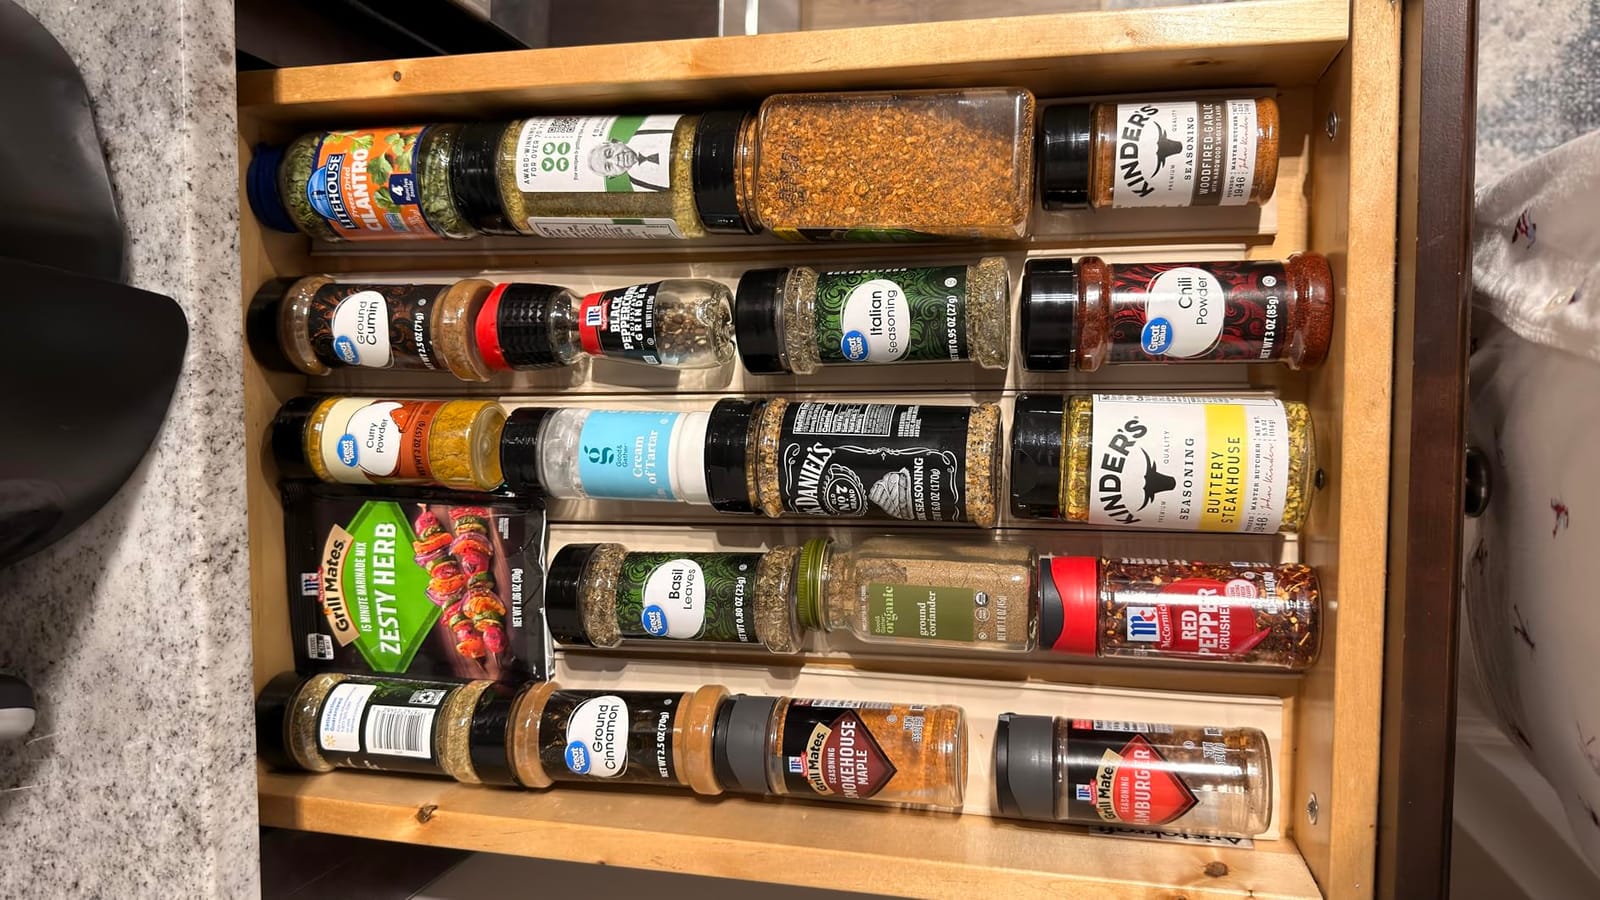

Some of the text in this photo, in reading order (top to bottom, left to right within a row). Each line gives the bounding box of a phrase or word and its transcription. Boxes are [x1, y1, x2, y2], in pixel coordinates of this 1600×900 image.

[523, 127, 537, 184] AWARD-WINNING
[531, 140, 540, 159] OVER
[1120, 104, 1159, 198] KINDER'S
[1184, 116, 1195, 180] SEASONING
[1199, 103, 1213, 195] WOODFIRED GARLIC
[1212, 146, 1221, 179] HARDWOOD
[326, 154, 357, 229] LITEHOUSE
[343, 166, 352, 191] Dried
[352, 149, 383, 231] CILANTRO
[391, 183, 404, 197] 4
[946, 295, 958, 316] (27g)
[1178, 277, 1192, 309] Chili
[1196, 276, 1208, 325] Powder
[1266, 295, 1279, 318] (85g)
[356, 301, 368, 345] Ground
[366, 301, 379, 345] Cumin
[414, 312, 425, 332] (71g)
[610, 296, 623, 333] BLACK
[620, 285, 639, 350] PEPPERCORN
[634, 287, 648, 341] GRINDER
[869, 290, 883, 336] Italian
[887, 289, 898, 353] Seasoning
[946, 316, 956, 328] OZ
[1265, 319, 1276, 330] OZ
[414, 332, 423, 342] OZ
[416, 342, 426, 353] 2.5
[847, 337, 860, 359] Great
[947, 328, 957, 345] 0.95
[1147, 322, 1167, 351] Great Value
[1262, 337, 1274, 349] WT
[366, 422, 378, 449] Curry
[376, 418, 389, 453] Powder
[413, 439, 421, 448] OZ
[414, 421, 425, 438] (57g)
[343, 439, 352, 464] Great
[632, 434, 645, 478] Cream
[645, 430, 658, 484] of Tartar
[794, 441, 833, 506] DANIEL'S
[836, 484, 848, 494] 7
[913, 457, 925, 512] SEASONING
[930, 468, 941, 491] (170g)
[1099, 420, 1148, 525] KINDER'S
[1179, 437, 1194, 521] SEASONING
[1206, 451, 1224, 514] BUTTERY
[1221, 436, 1240, 524] STEAKHOUSE
[1250, 443, 1261, 511] MASTER BUTCHER
[930, 491, 940, 501] OZ
[324, 539, 350, 632] Grill Mates
[353, 541, 372, 632] 15 MINUTE MARINADE MIX
[372, 522, 401, 655] ZESTY HERB
[511, 583, 522, 592] OZ
[668, 569, 684, 600] Basil
[683, 568, 696, 610] Leaves
[512, 605, 522, 617] WT
[512, 617, 523, 628] NET
[650, 611, 659, 634] Great
[734, 576, 746, 634] WT 0.80 OZ (23g)
[885, 585, 899, 634] organic
[917, 602, 929, 636] ground
[926, 590, 937, 637] coriander
[1158, 604, 1171, 648] McCormic
[1181, 609, 1198, 641] RED
[1219, 602, 1231, 651] CRUSHE
[592, 704, 609, 753] Ground
[604, 704, 620, 770] Cinnamon
[656, 731, 665, 742] OZ
[657, 711, 670, 731] (70g)
[572, 747, 581, 770] Great
[656, 742, 666, 756] 2.5
[657, 755, 666, 767] WT
[808, 733, 827, 792] Grill Mates
[827, 747, 837, 784] SEASONING
[856, 749, 868, 785] MAPLE
[1099, 801, 1116, 820] Grill
[1119, 776, 1129, 813] SEASONING
